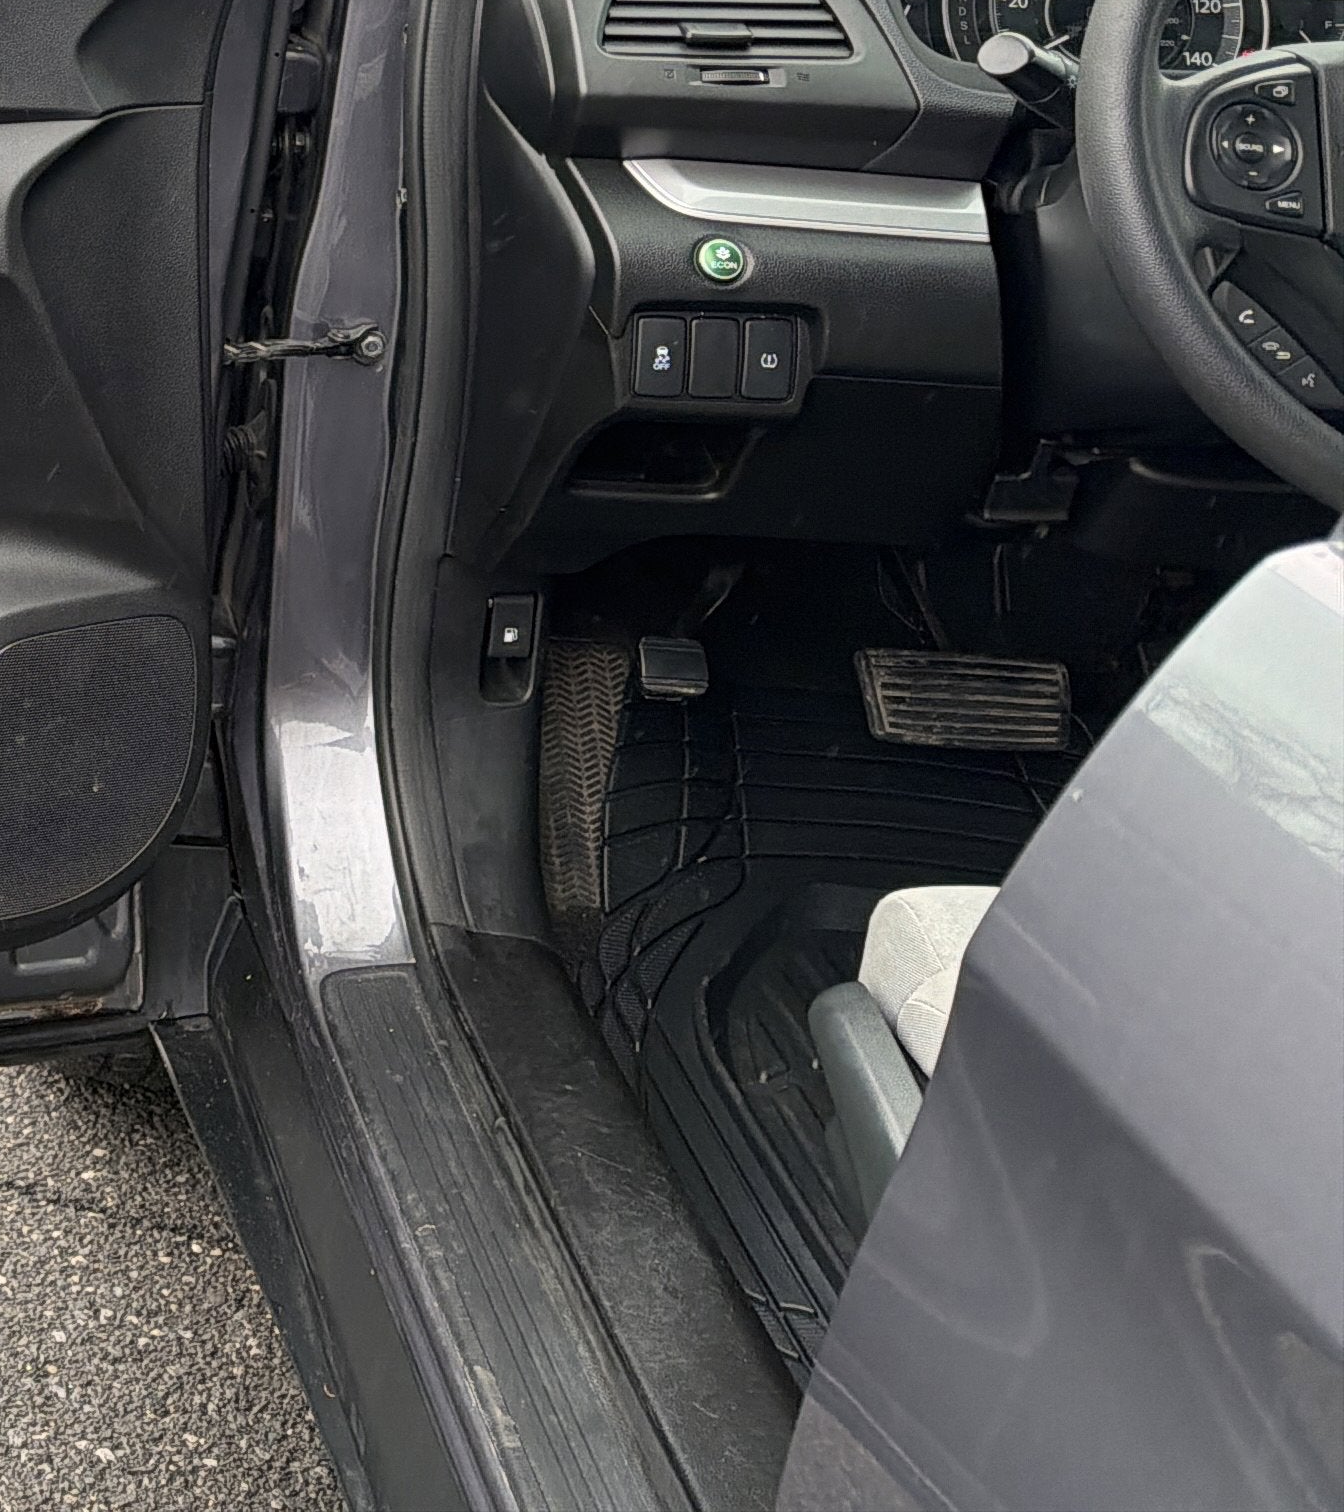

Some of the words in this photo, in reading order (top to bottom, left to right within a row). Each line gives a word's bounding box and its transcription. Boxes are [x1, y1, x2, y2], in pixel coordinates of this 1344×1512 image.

[958, 7, 967, 16] D
[1192, 0, 1222, 14] 120
[960, 21, 969, 31] S
[1325, 21, 1333, 29] F
[964, 35, 971, 45] L
[1183, 52, 1212, 66] 140
[1277, 200, 1301, 209] MENU
[711, 260, 738, 270] ECON
[652, 362, 671, 371] OFF
